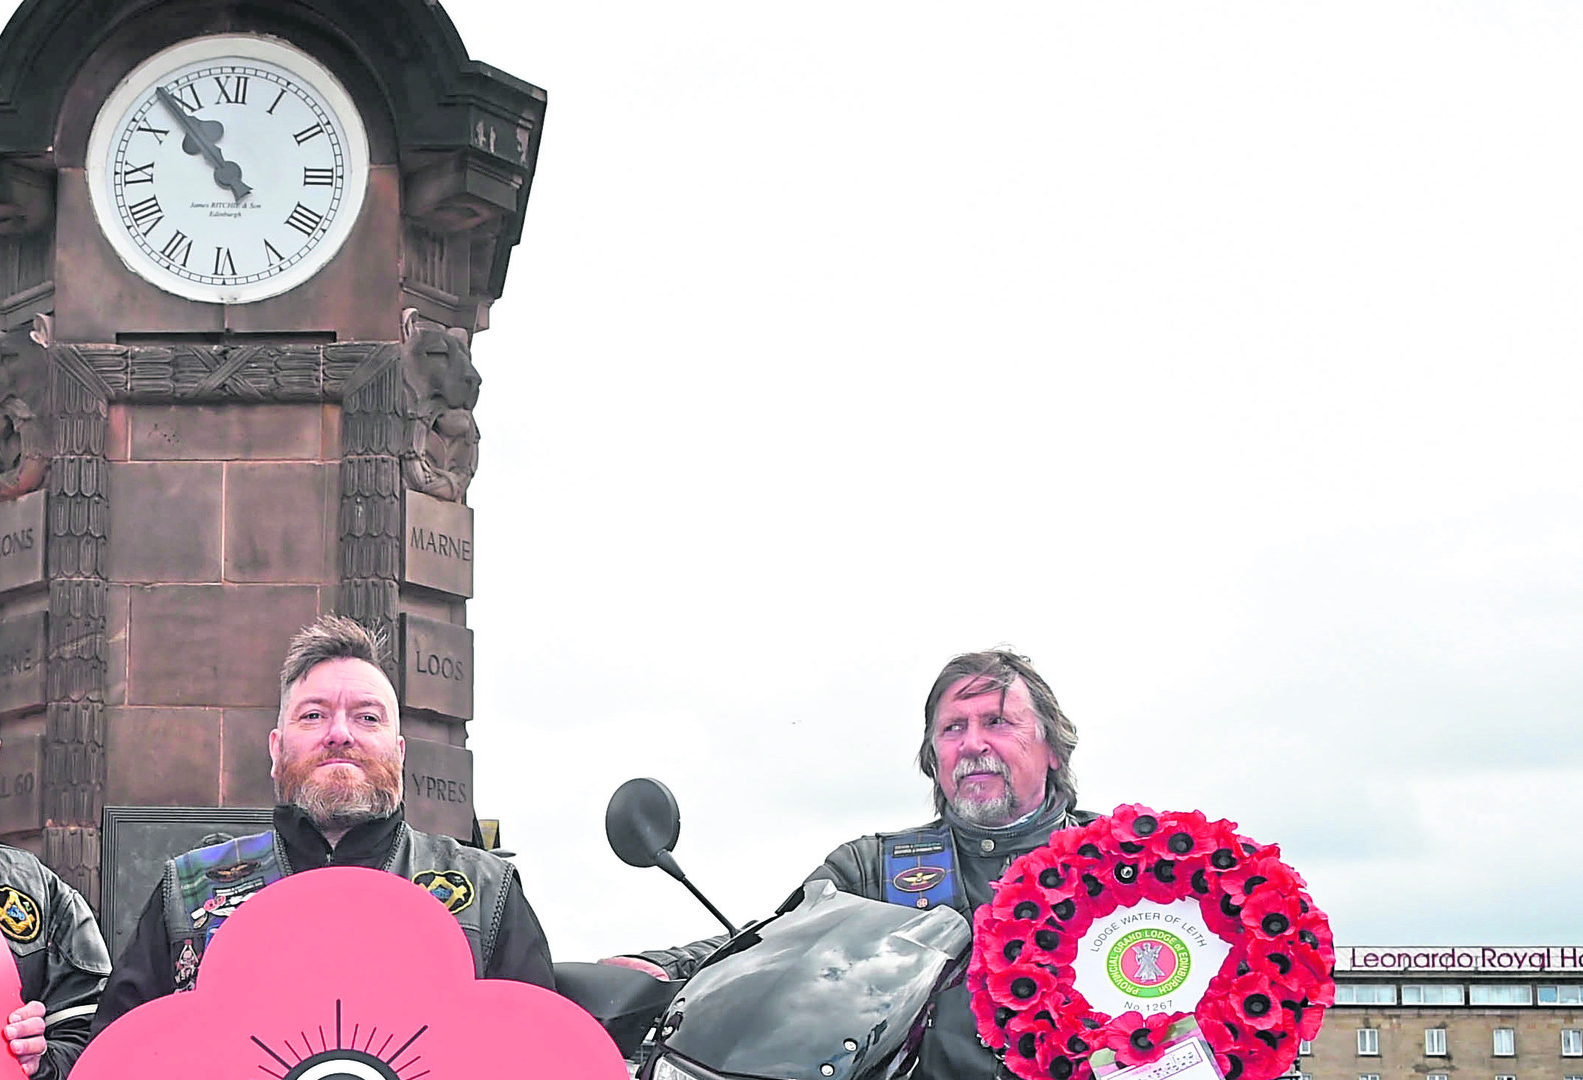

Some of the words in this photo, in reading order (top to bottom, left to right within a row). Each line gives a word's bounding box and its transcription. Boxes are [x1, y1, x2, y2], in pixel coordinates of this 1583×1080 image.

[214, 76, 249, 105] XII
[266, 89, 287, 115] I
[137, 118, 170, 145] X
[293, 122, 325, 146] II
[124, 161, 155, 187] IX
[303, 166, 334, 187] III
[128, 194, 165, 238] VIII
[190, 201, 210, 209] James
[209, 210, 242, 219] Edinburgh
[284, 201, 324, 238] IIII
[160, 229, 194, 268] VII
[212, 246, 237, 276] VI
[263, 238, 285, 266] V
[410, 526, 472, 562] MARNE
[416, 650, 465, 682] LOOS
[15, 771, 34, 796] 60
[412, 773, 467, 804] YPRES
[1090, 922, 1120, 953] LODGE
[1120, 912, 1161, 925] WATER
[1164, 914, 1181, 924] OF
[1181, 922, 1208, 948] LEITH
[1114, 932, 1142, 953] GRAND
[1144, 930, 1177, 945] LODGE
[1352, 947, 1474, 968] Leonardo
[1481, 947, 1551, 969] Royal
[1108, 953, 1138, 995] PROVINCIAL
[1158, 951, 1190, 995] EDINBURGH
[1146, 1000, 1173, 1012] 1267
